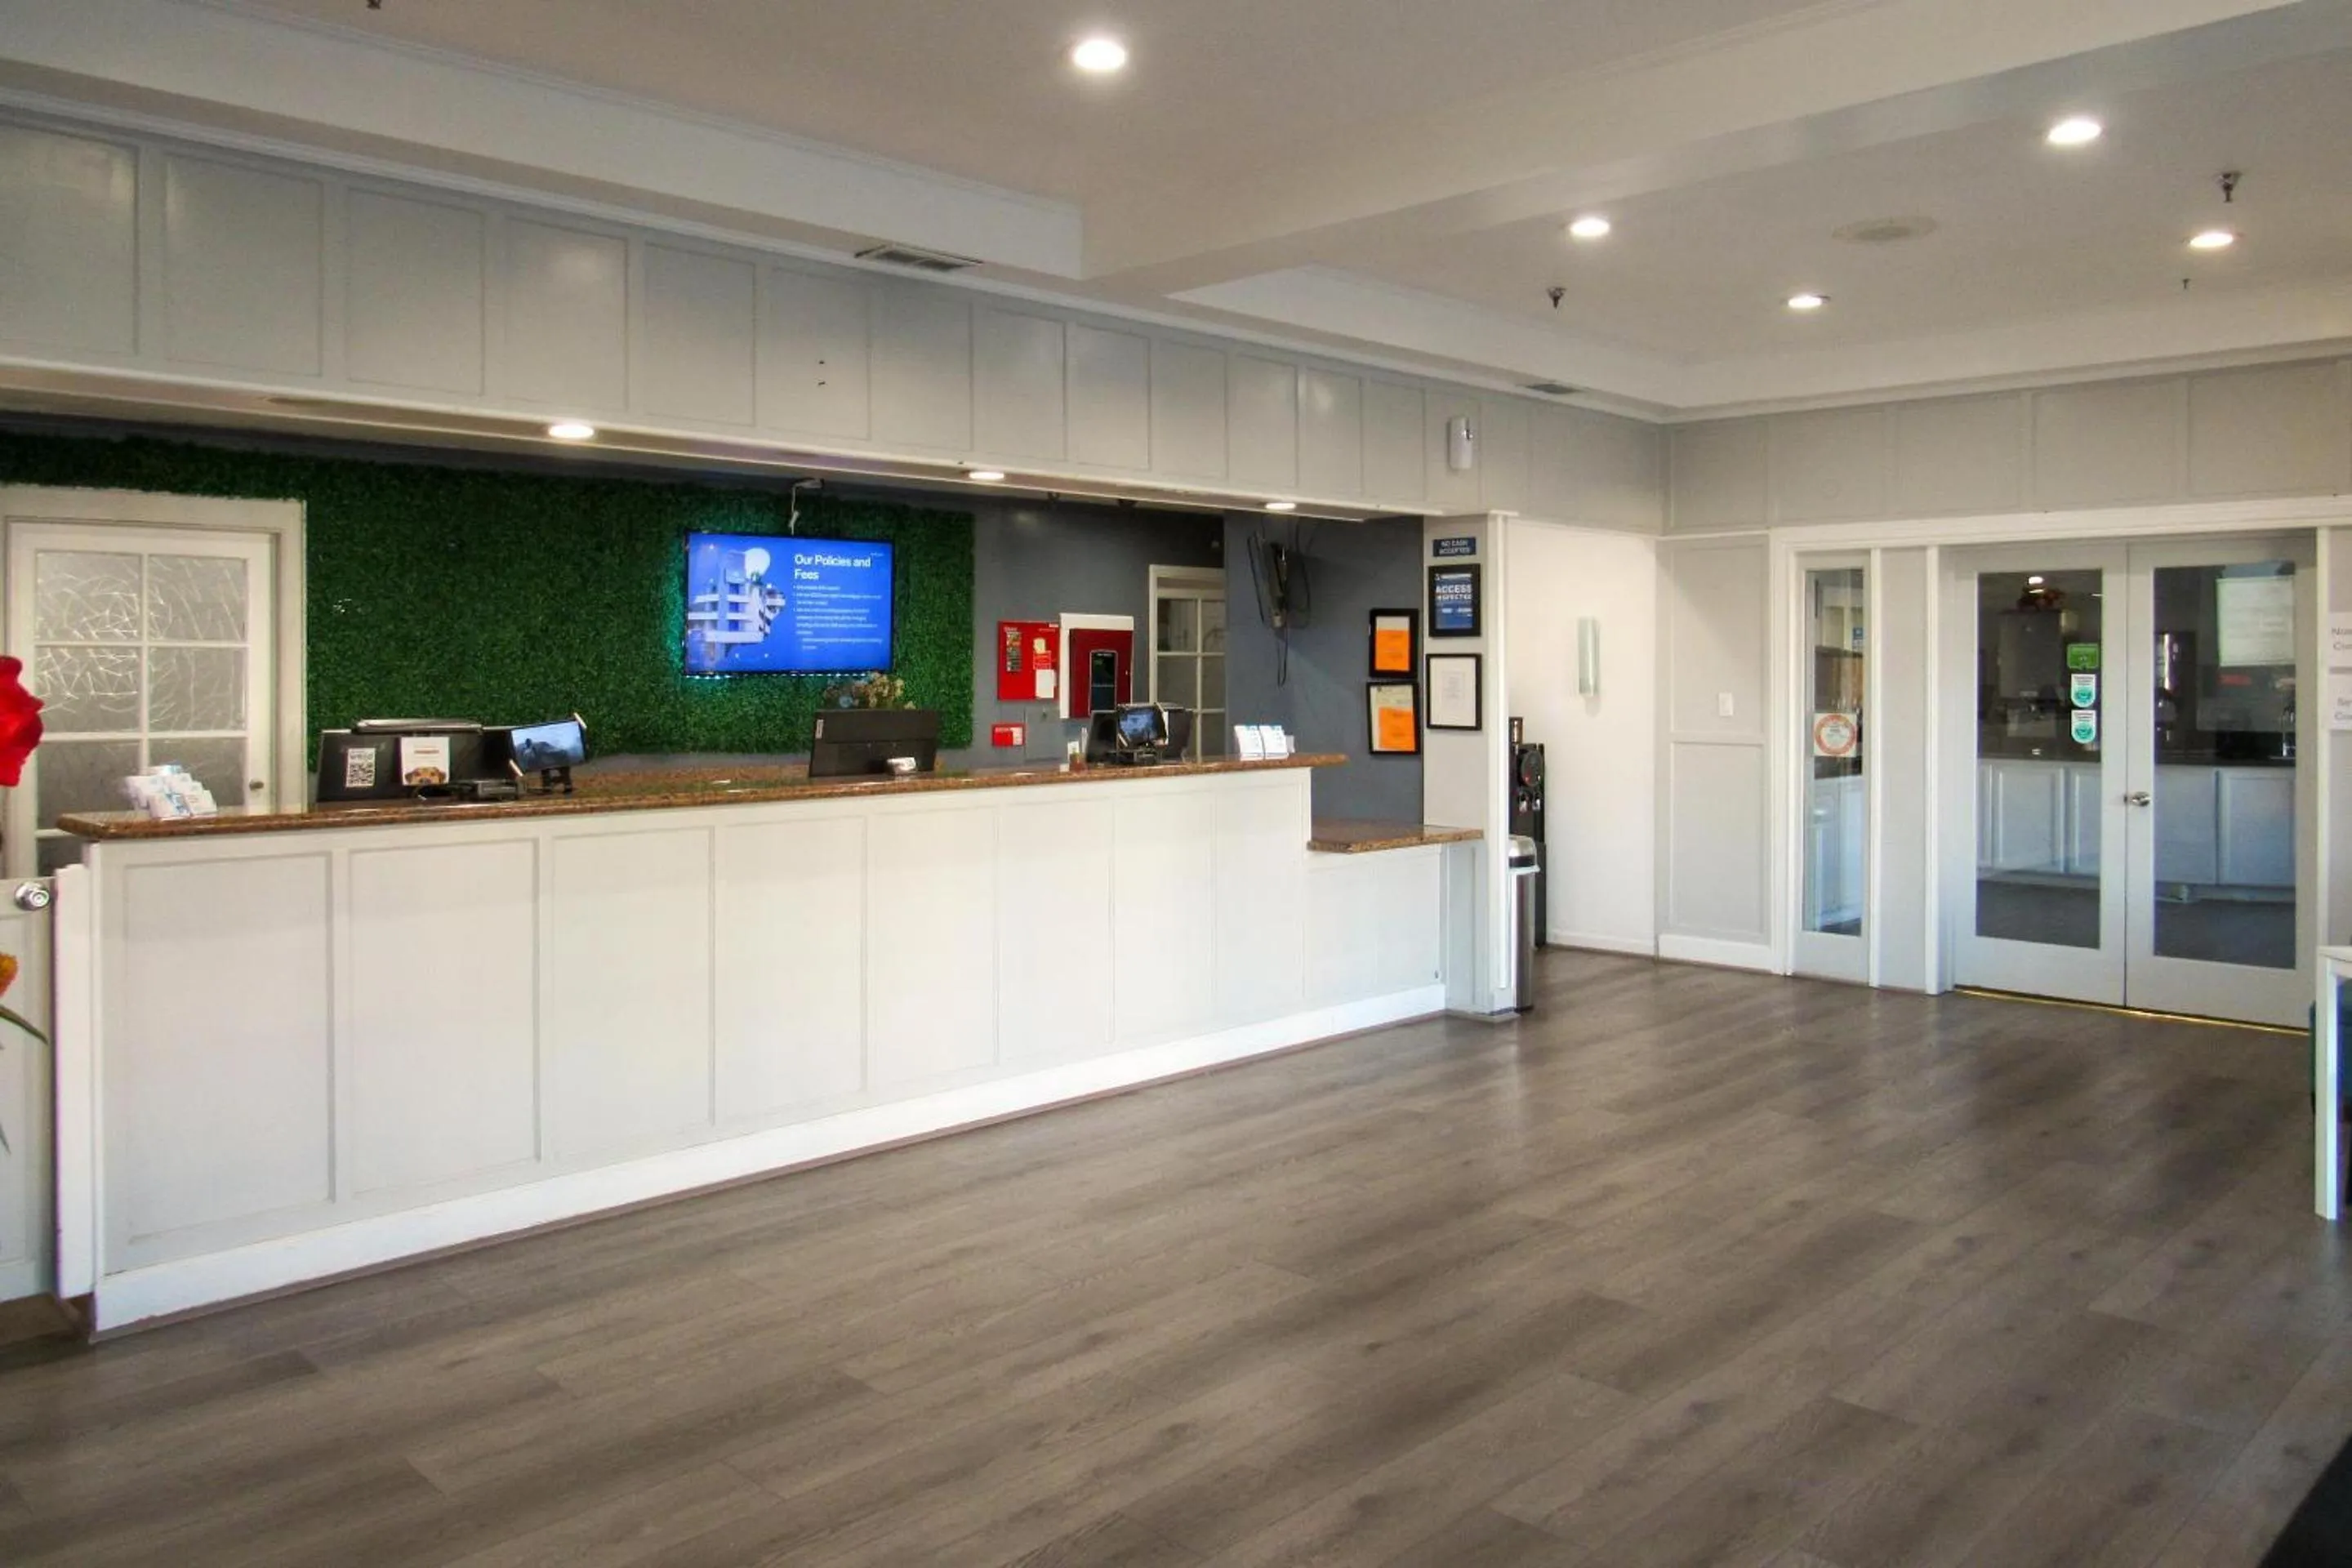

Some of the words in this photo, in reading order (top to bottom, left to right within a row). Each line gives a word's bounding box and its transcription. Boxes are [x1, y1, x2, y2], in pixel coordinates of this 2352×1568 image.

[794, 554, 812, 565] Our
[814, 555, 852, 567] Policies
[853, 557, 871, 567] and
[794, 568, 820, 580] Fees
[1436, 584, 1472, 593] ACCESS
